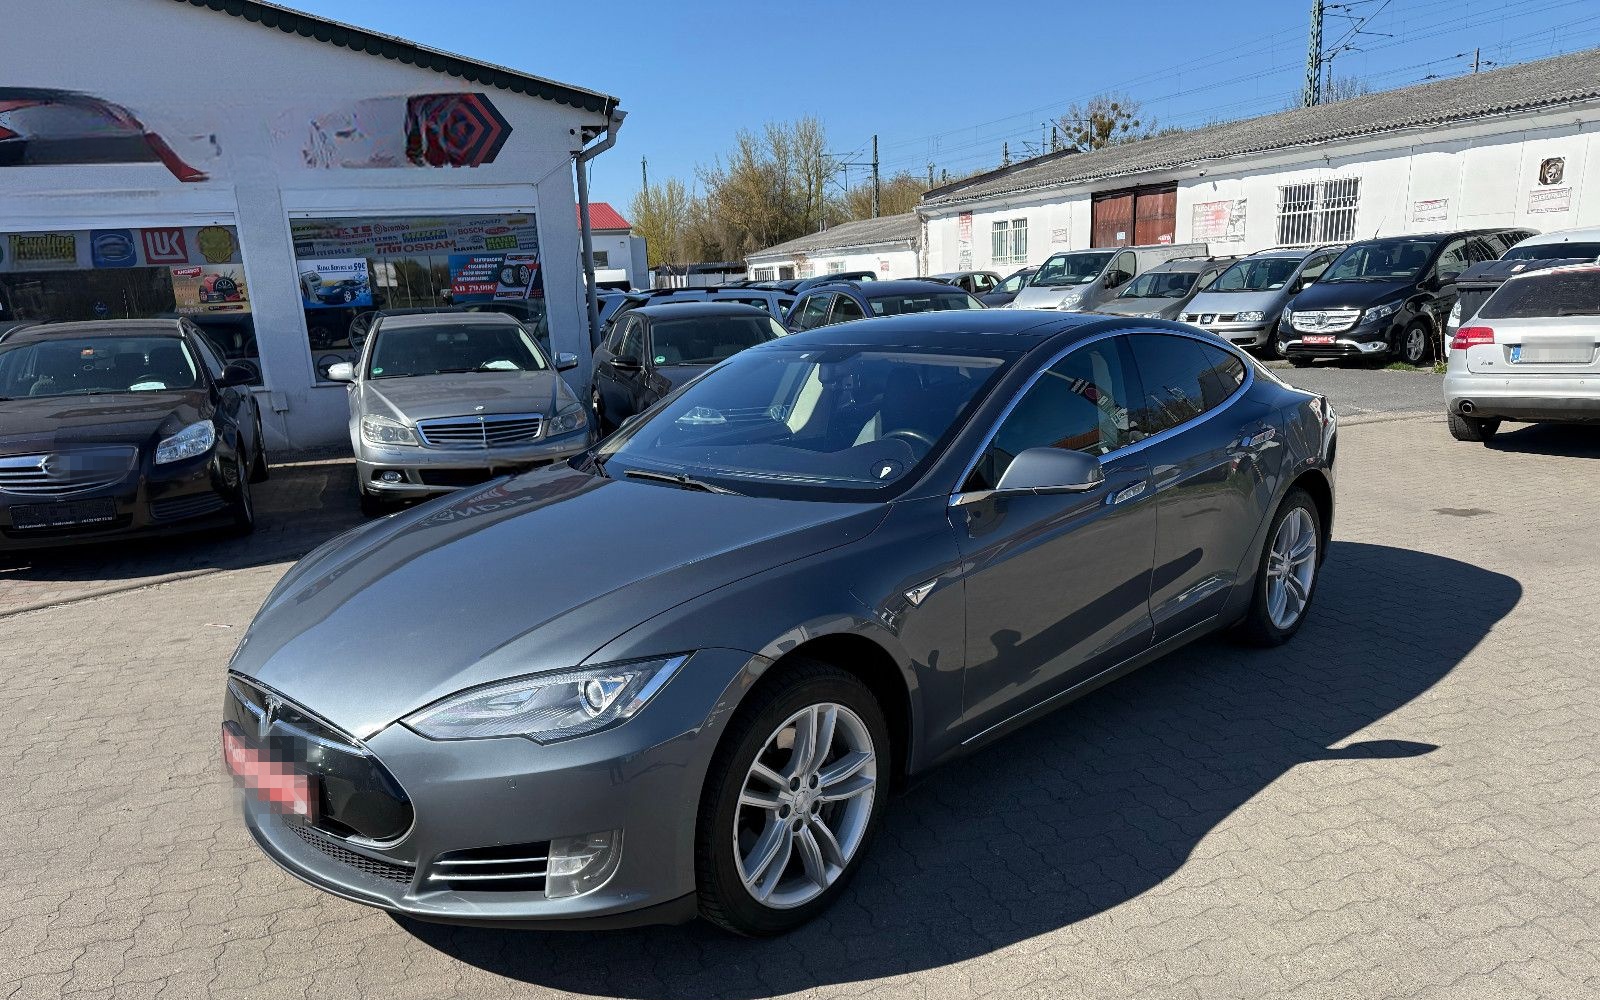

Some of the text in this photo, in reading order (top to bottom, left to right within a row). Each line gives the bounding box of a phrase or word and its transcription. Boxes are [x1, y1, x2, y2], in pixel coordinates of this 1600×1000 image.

[382, 224, 410, 233] brembo
[457, 227, 484, 236] BOSCH
[486, 236, 515, 244] MANN
[147, 231, 185, 261] LUK
[402, 239, 457, 253] OSRAM
[353, 262, 366, 271] 59€
